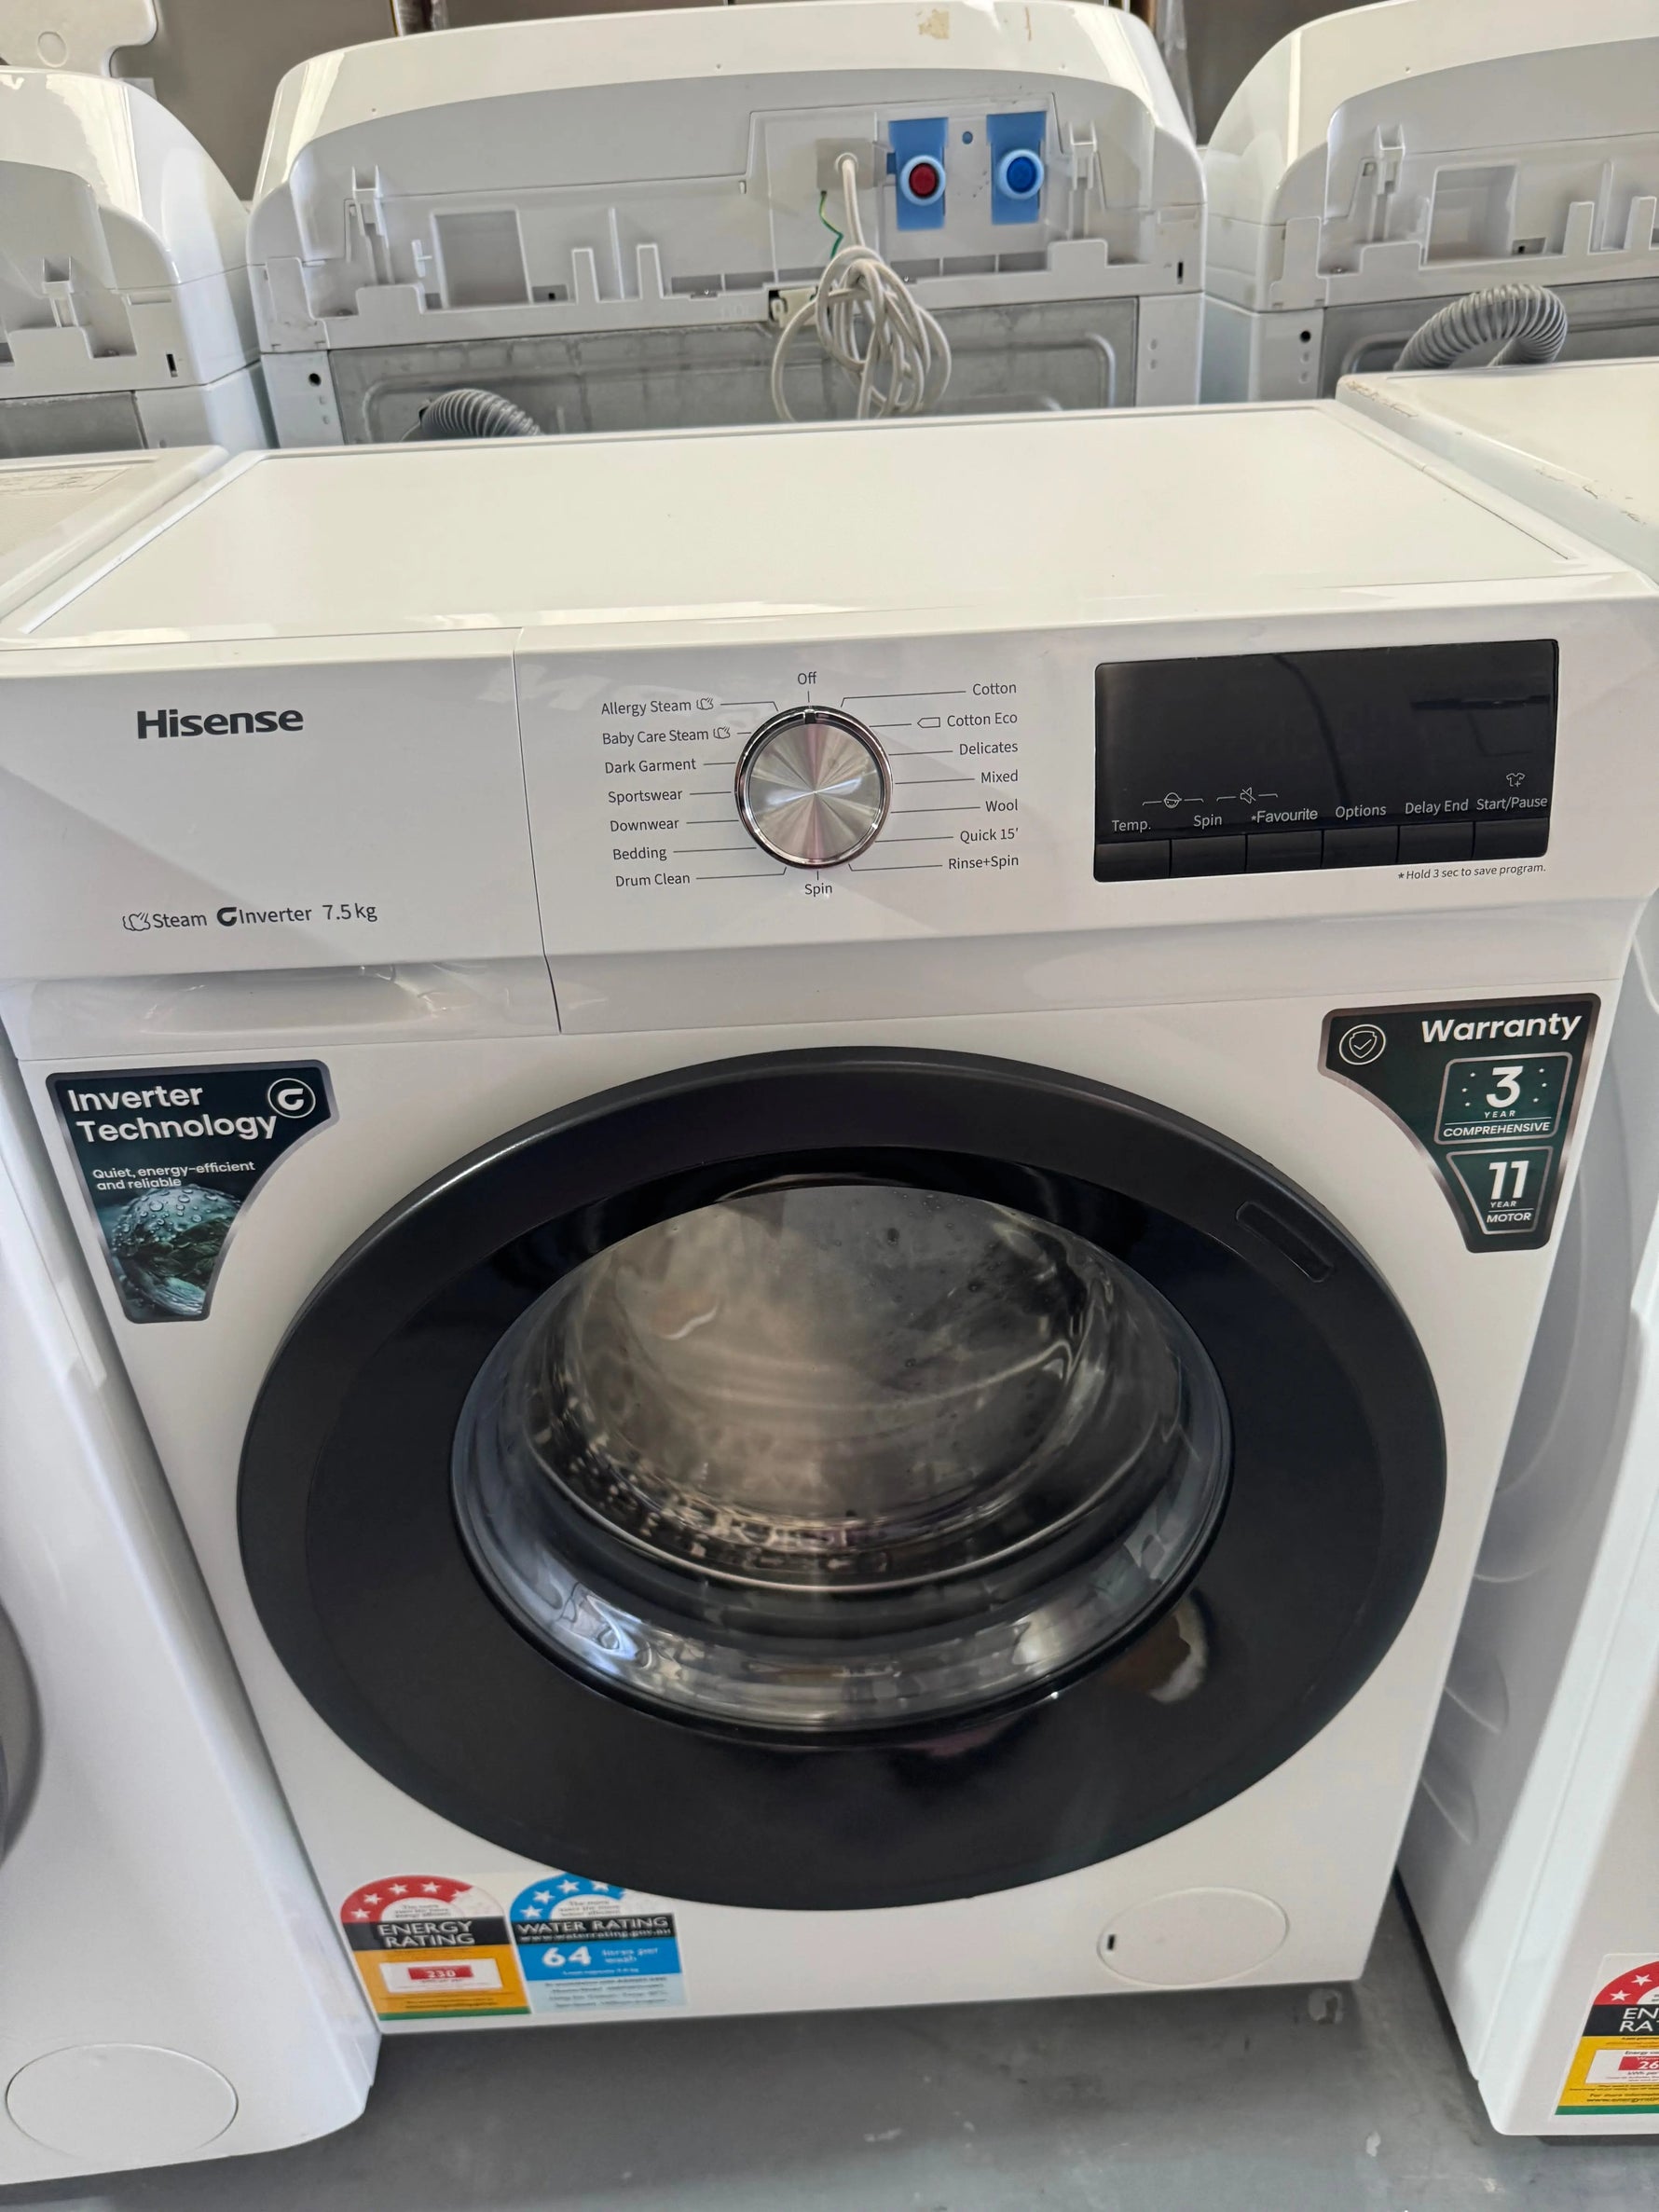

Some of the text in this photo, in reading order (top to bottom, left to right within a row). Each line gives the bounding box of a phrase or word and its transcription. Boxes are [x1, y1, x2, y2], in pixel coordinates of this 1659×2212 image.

[797, 671, 817, 685] Off
[972, 681, 1018, 696] Cotton
[601, 700, 692, 717] Allergy Steam
[137, 708, 304, 739] Hisense
[946, 711, 1019, 728] Cotton Eco
[602, 729, 709, 748] Baby Care Steam
[958, 740, 1019, 756] Delicates
[605, 758, 697, 774] Dark Garment
[980, 769, 1019, 784] Mixed
[608, 789, 683, 805] Sportswear
[1476, 796, 1548, 811] Start/Pause
[985, 798, 1019, 813] Wool
[1335, 804, 1387, 819] Options
[1405, 799, 1469, 817] Delay End
[610, 817, 680, 832] Downwear
[1112, 818, 1152, 834] Temp.
[1193, 813, 1224, 829] Spin
[959, 829, 997, 843] Quick
[612, 845, 667, 860] Bedding
[948, 855, 1020, 871] Rinse+Spin
[1433, 869, 1439, 878] 3
[1441, 868, 1459, 877] sec
[1460, 867, 1472, 877] to
[1474, 867, 1498, 876] save
[1499, 864, 1546, 876] program.
[615, 872, 691, 887] Drum Clean
[803, 882, 833, 897] Spin
[152, 912, 208, 929] Steam
[322, 904, 352, 921] 7.5
[355, 902, 378, 923] kg
[1420, 1012, 1582, 1044] Warranty
[1486, 1065, 1524, 1108] 3
[66, 1085, 203, 1113] Inverter
[1484, 1109, 1516, 1120] YEAR
[75, 1114, 278, 1144] Technology
[1443, 1121, 1551, 1137] COMPREHENSIVE
[92, 1161, 256, 1181] Quiet, energy-efficient
[96, 1176, 182, 1191] and reliable
[1488, 1160, 1529, 1200] 11
[1490, 1200, 1517, 1208] YEAR
[1486, 1212, 1532, 1224] MOTOR
[377, 1920, 473, 1938] ENERGY
[517, 1916, 669, 1935] WATER RATING
[384, 1932, 475, 1948] RATING
[542, 1945, 592, 1968] 64
[426, 1969, 457, 1978] 230
[1619, 2020, 1659, 2033] RA
